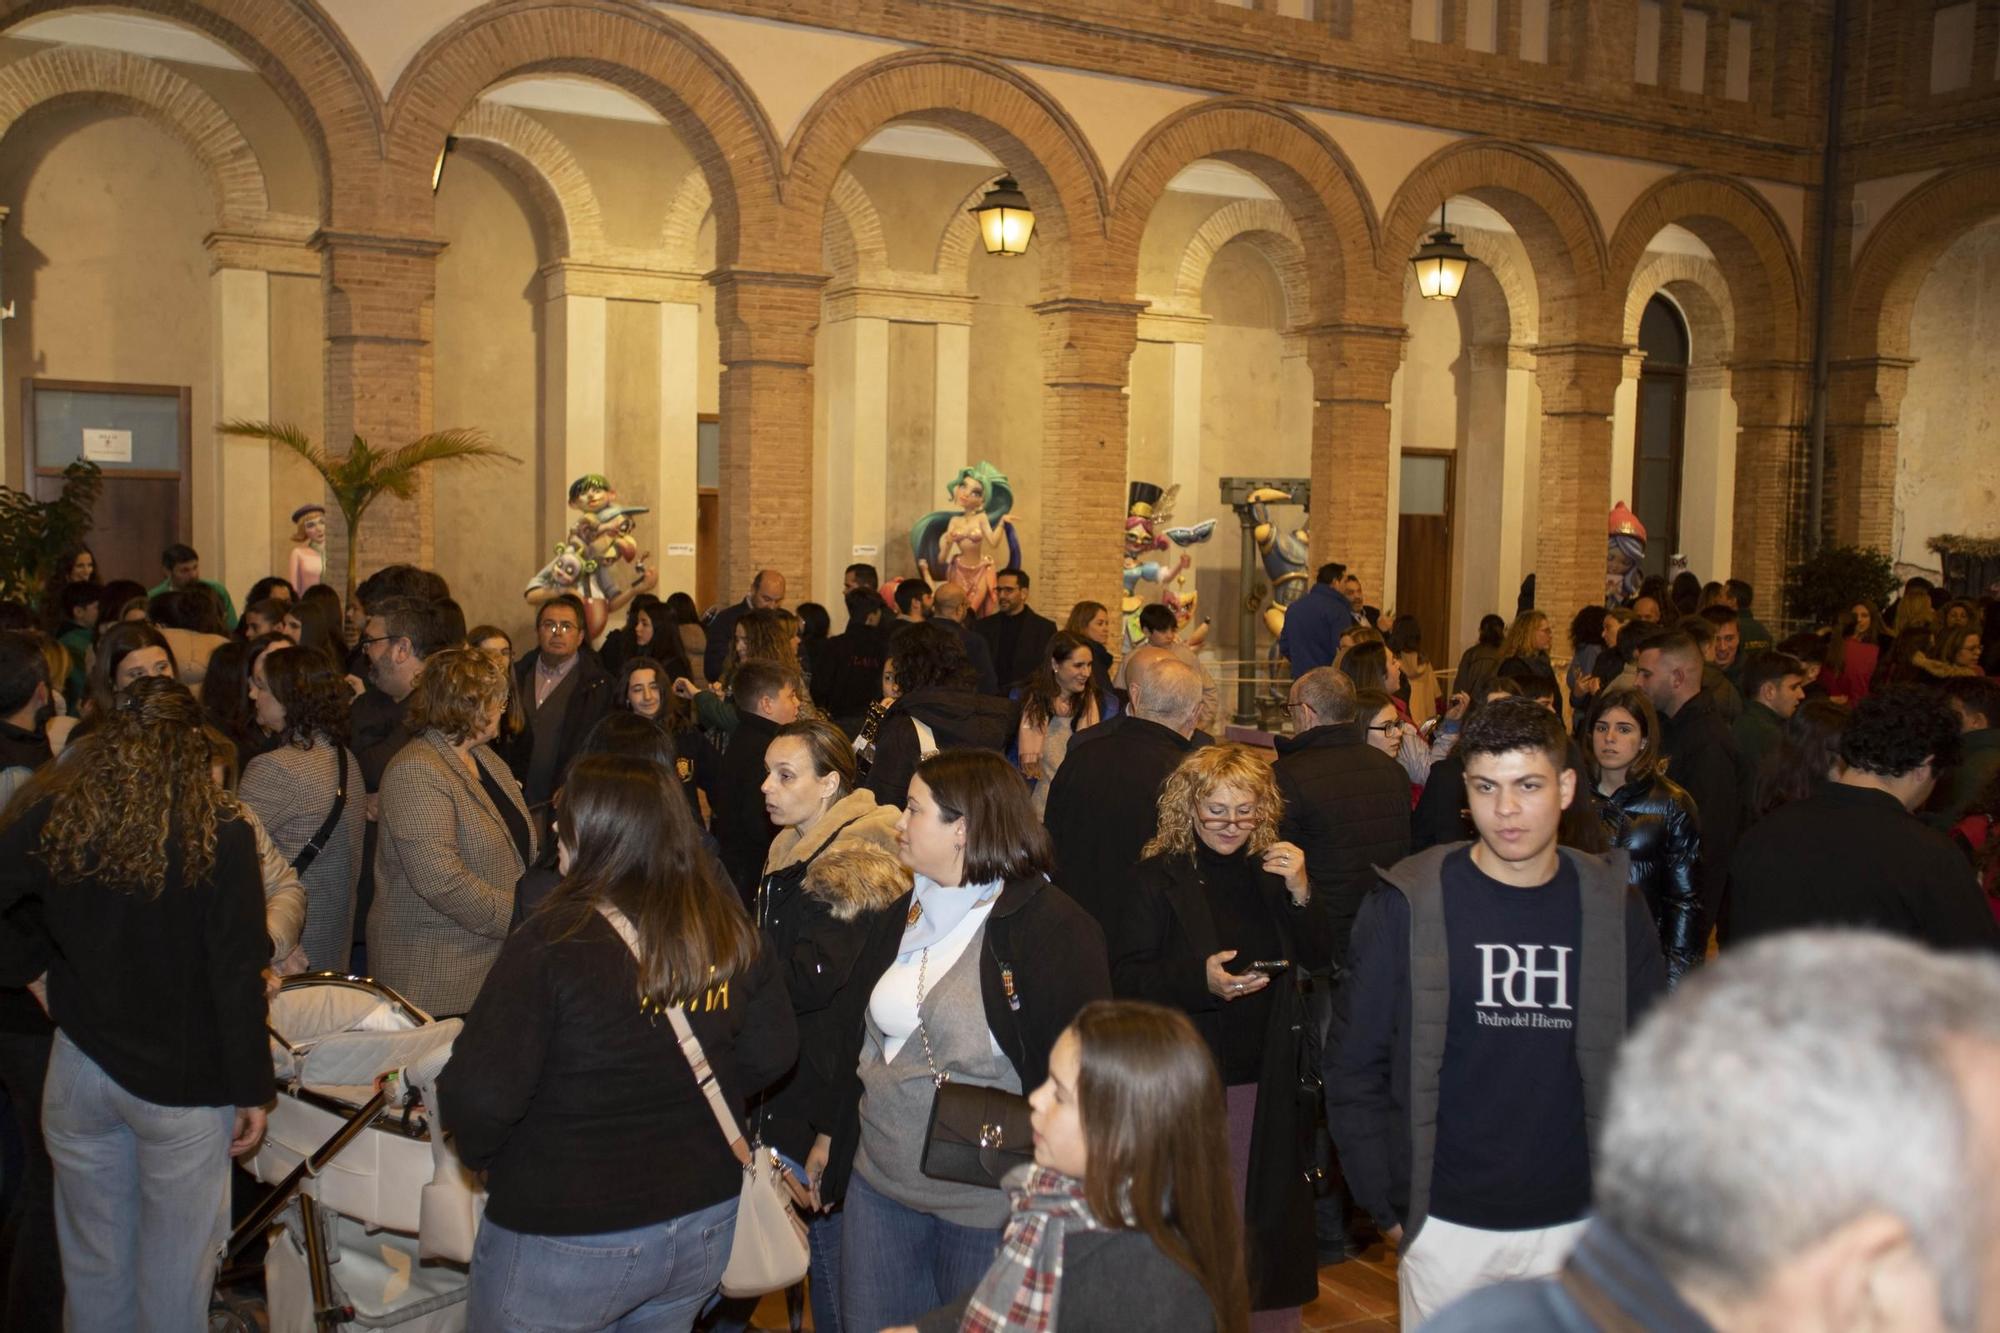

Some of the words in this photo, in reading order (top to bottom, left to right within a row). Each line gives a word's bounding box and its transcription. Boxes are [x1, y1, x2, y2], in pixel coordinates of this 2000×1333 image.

[1476, 1011, 1510, 1026] Pedro
[1511, 1012, 1530, 1027] del
[1532, 1013, 1573, 1029] Hierro
